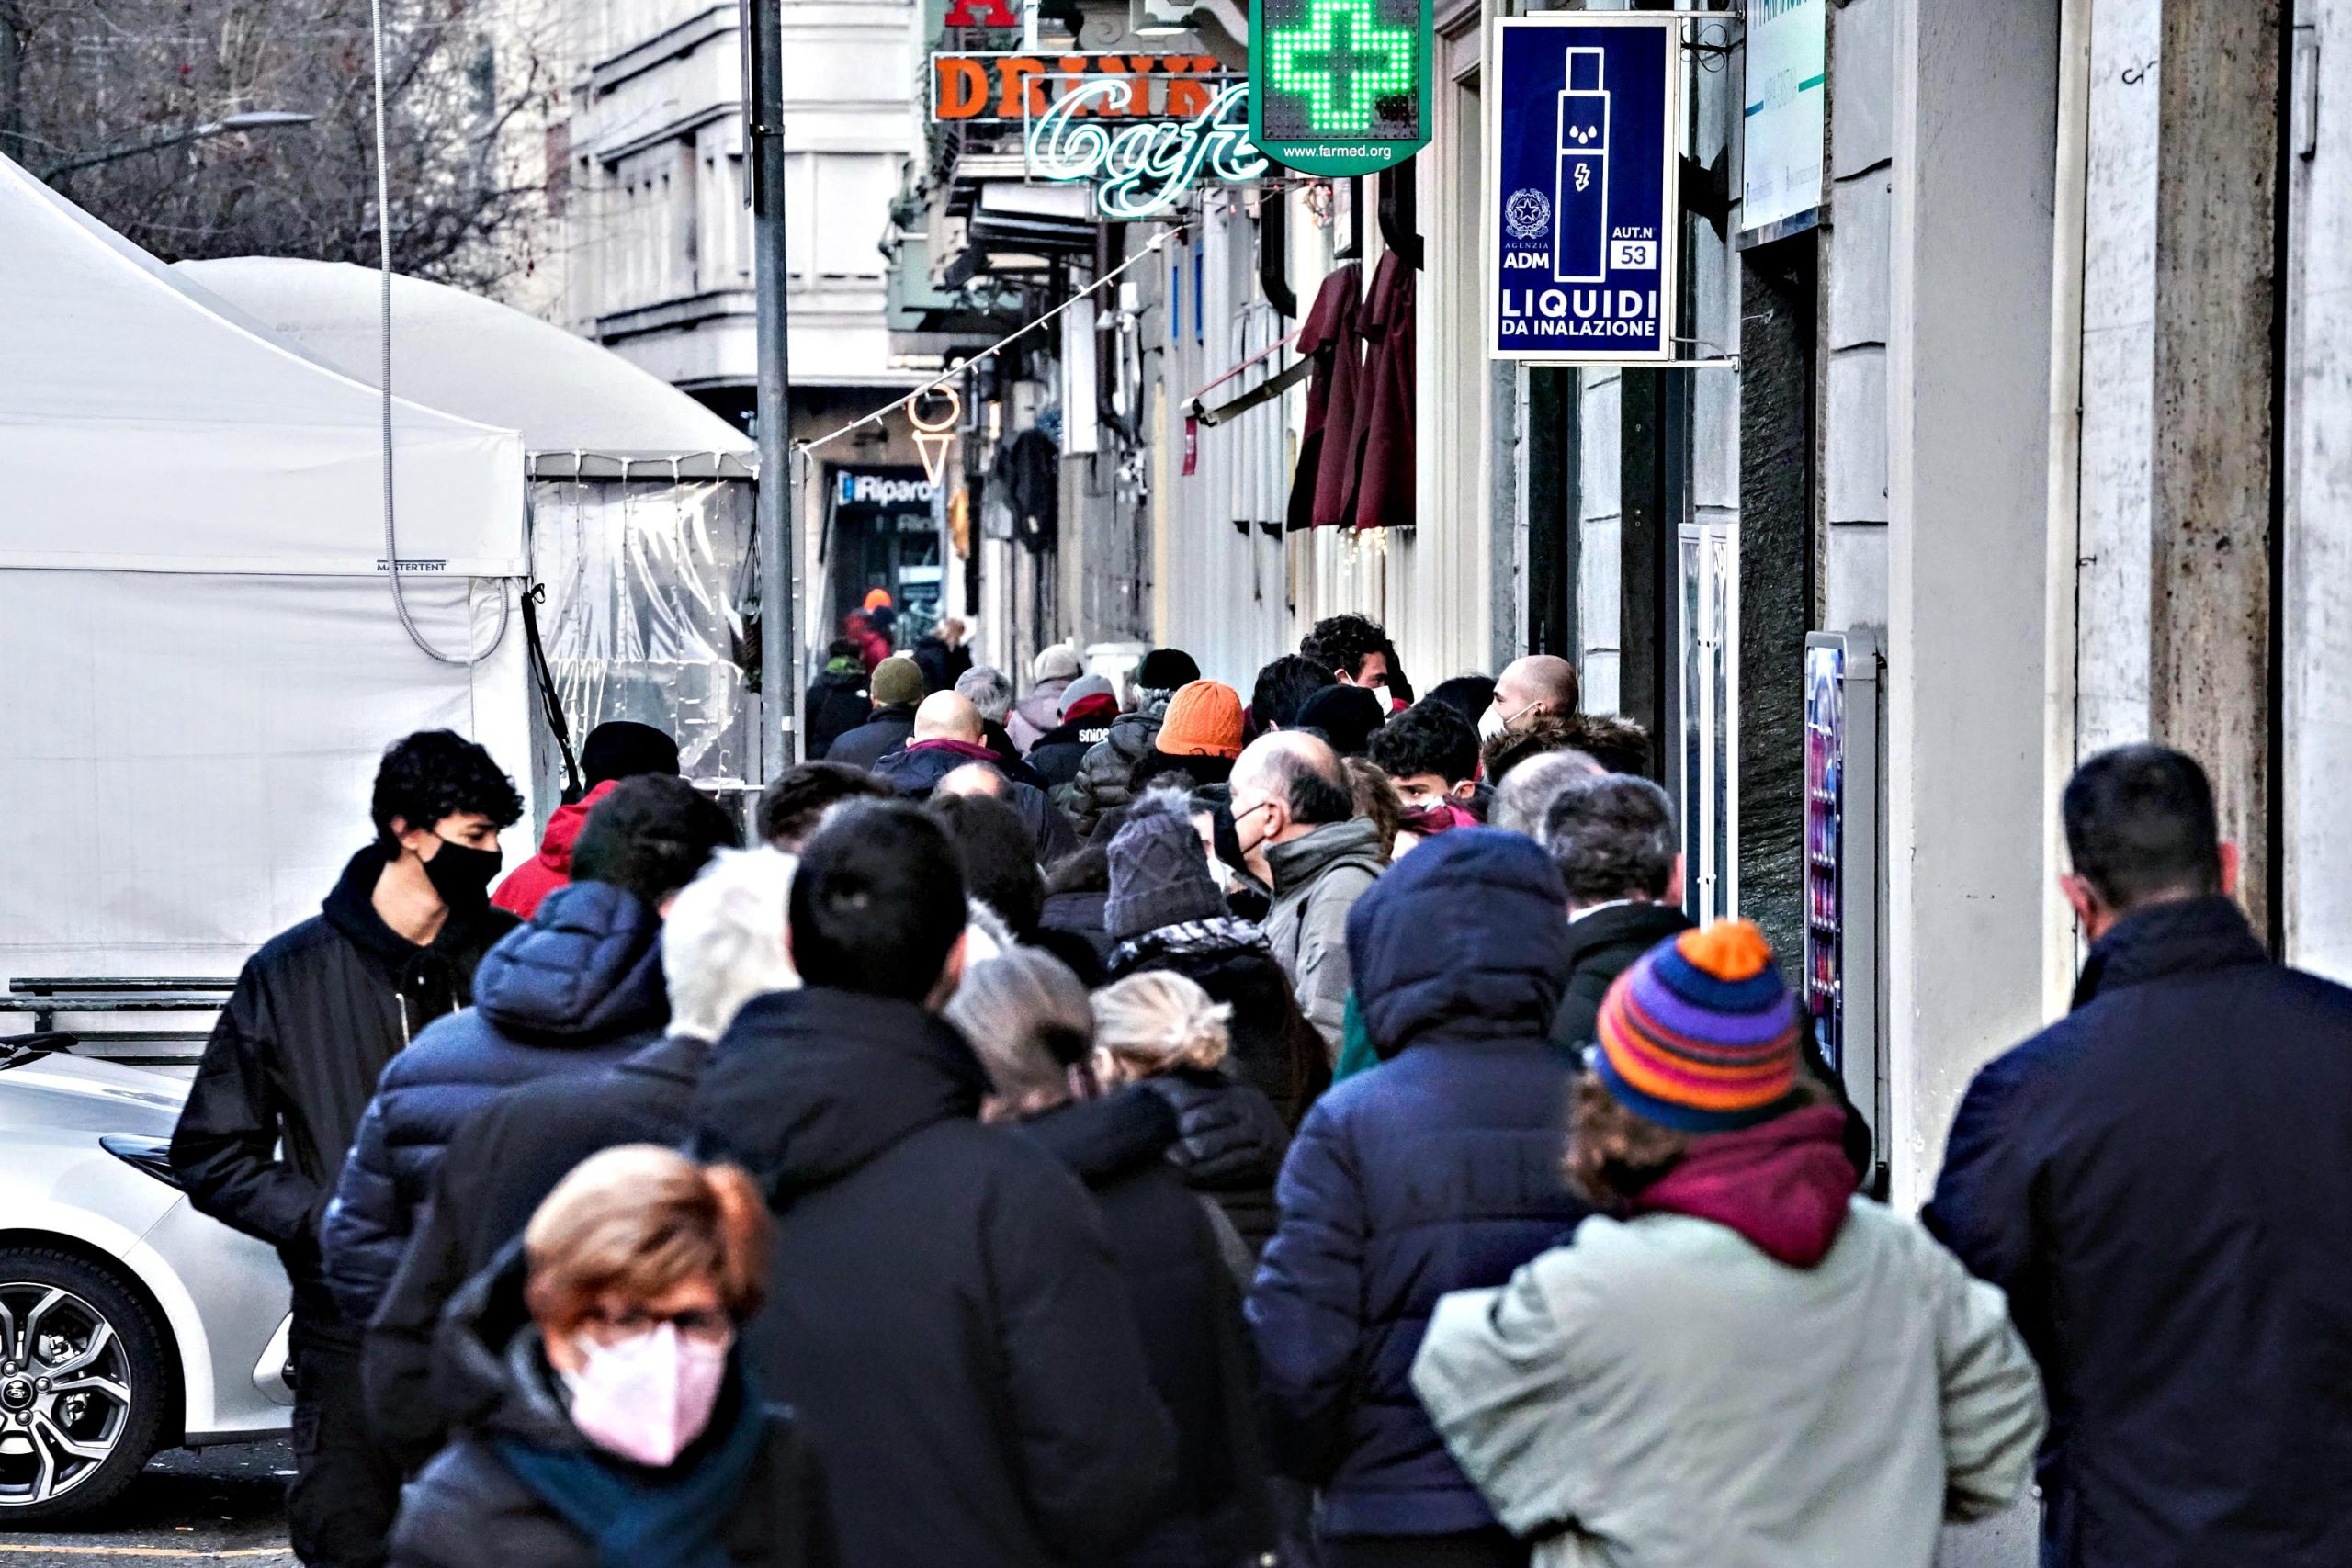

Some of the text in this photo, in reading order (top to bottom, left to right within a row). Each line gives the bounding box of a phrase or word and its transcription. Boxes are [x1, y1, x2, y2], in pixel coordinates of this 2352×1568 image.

[935, 55, 1220, 119] DRINK
[1283, 144, 1392, 160] www.farmed.org
[1503, 252, 1550, 269] ADM
[1621, 245, 1646, 265] 53
[1502, 288, 1657, 319] LIQUIDI
[1501, 320, 1656, 337] DA INALAZIONE
